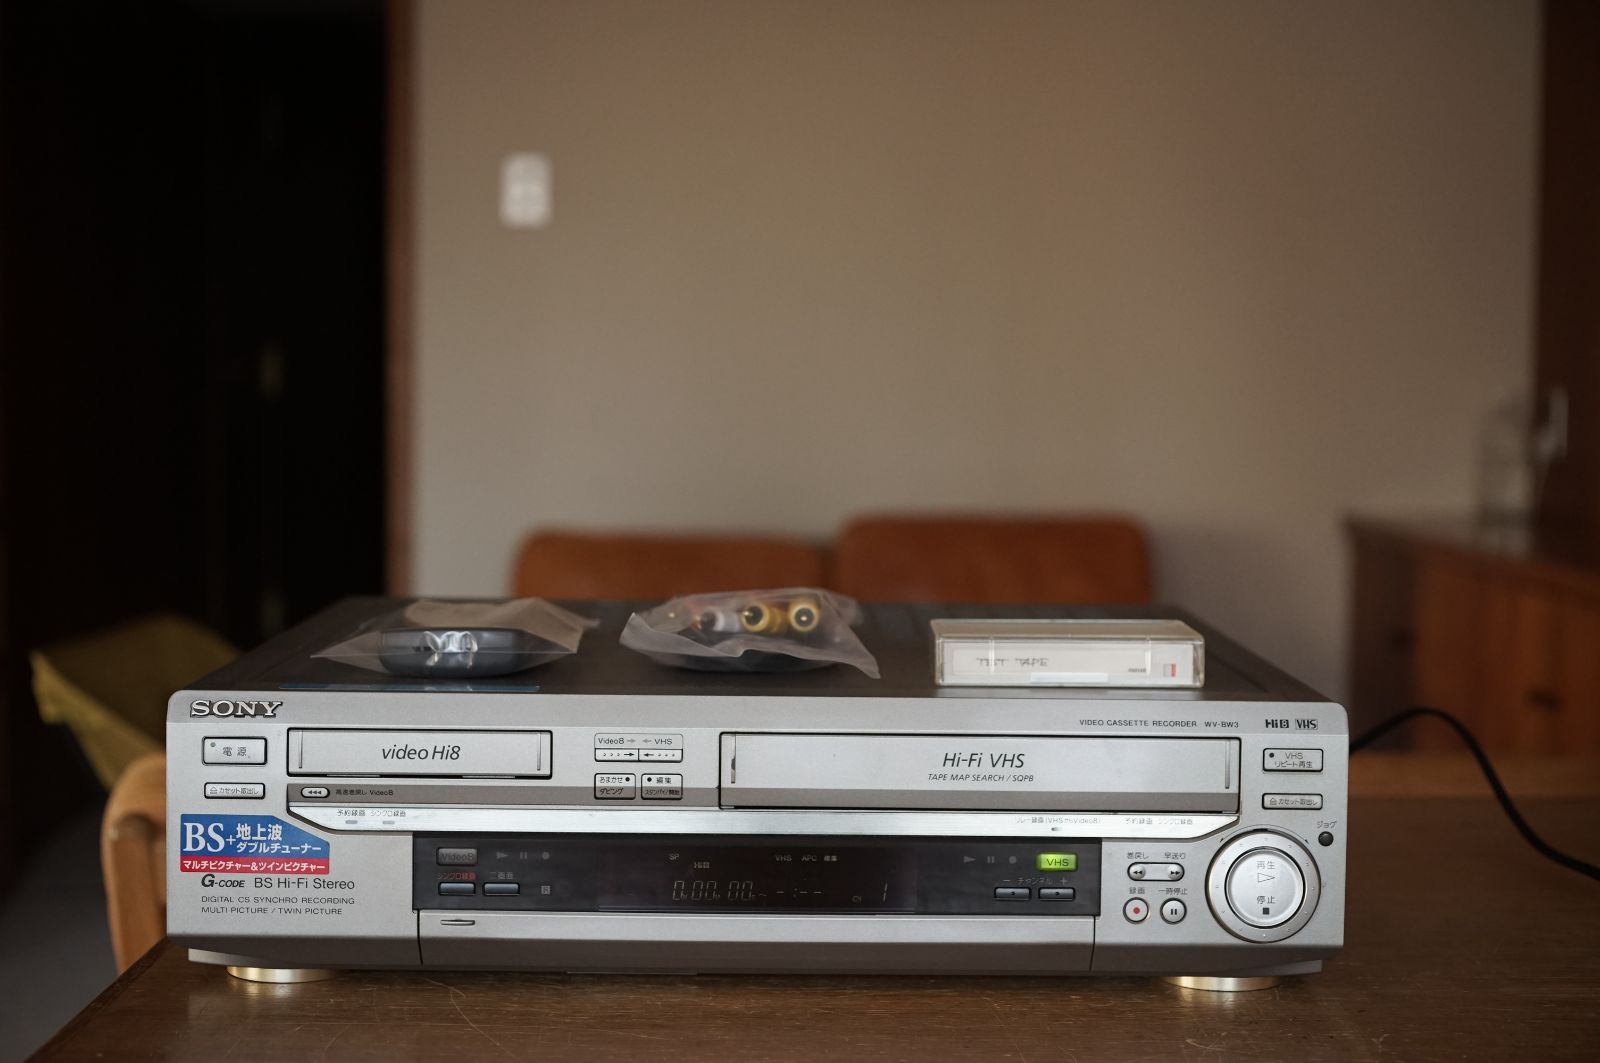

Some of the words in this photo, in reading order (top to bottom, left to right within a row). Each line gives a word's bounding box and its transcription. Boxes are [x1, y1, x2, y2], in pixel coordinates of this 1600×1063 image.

[190, 700, 283, 718] SONY
[1265, 719, 1289, 729] Hi8
[1295, 719, 1318, 730] VHS
[598, 737, 625, 745] Video8
[943, 752, 982, 768] Hi-Fi
[990, 753, 1025, 768] VHS
[1285, 752, 1304, 760] VHS
[1274, 760, 1313, 769] リピート再生
[599, 776, 624, 784] おまかせ
[928, 773, 948, 781] TAPE
[1012, 774, 1034, 782] SQPB
[600, 787, 624, 796] ダビング
[1316, 820, 1337, 829] ジョグ
[236, 823, 283, 841] 地上波
[236, 841, 322, 854] ダブルチューナー
[441, 851, 473, 861] Video8
[1164, 852, 1186, 860] 早送り
[1046, 858, 1069, 867] VHS
[1256, 860, 1275, 870] 再生
[201, 873, 246, 888] G-CODE
[254, 877, 273, 889] BS
[277, 877, 308, 889] Hi-Fi
[313, 877, 355, 890] Stereo
[1017, 877, 1053, 885] チャンネル
[201, 895, 234, 903] DIGITAL
[253, 896, 298, 904] SYNCHRO
[301, 896, 355, 905] RECORDING
[1256, 895, 1276, 904] 停止
[201, 906, 228, 914] MULTI
[304, 907, 342, 915] PICTURE
